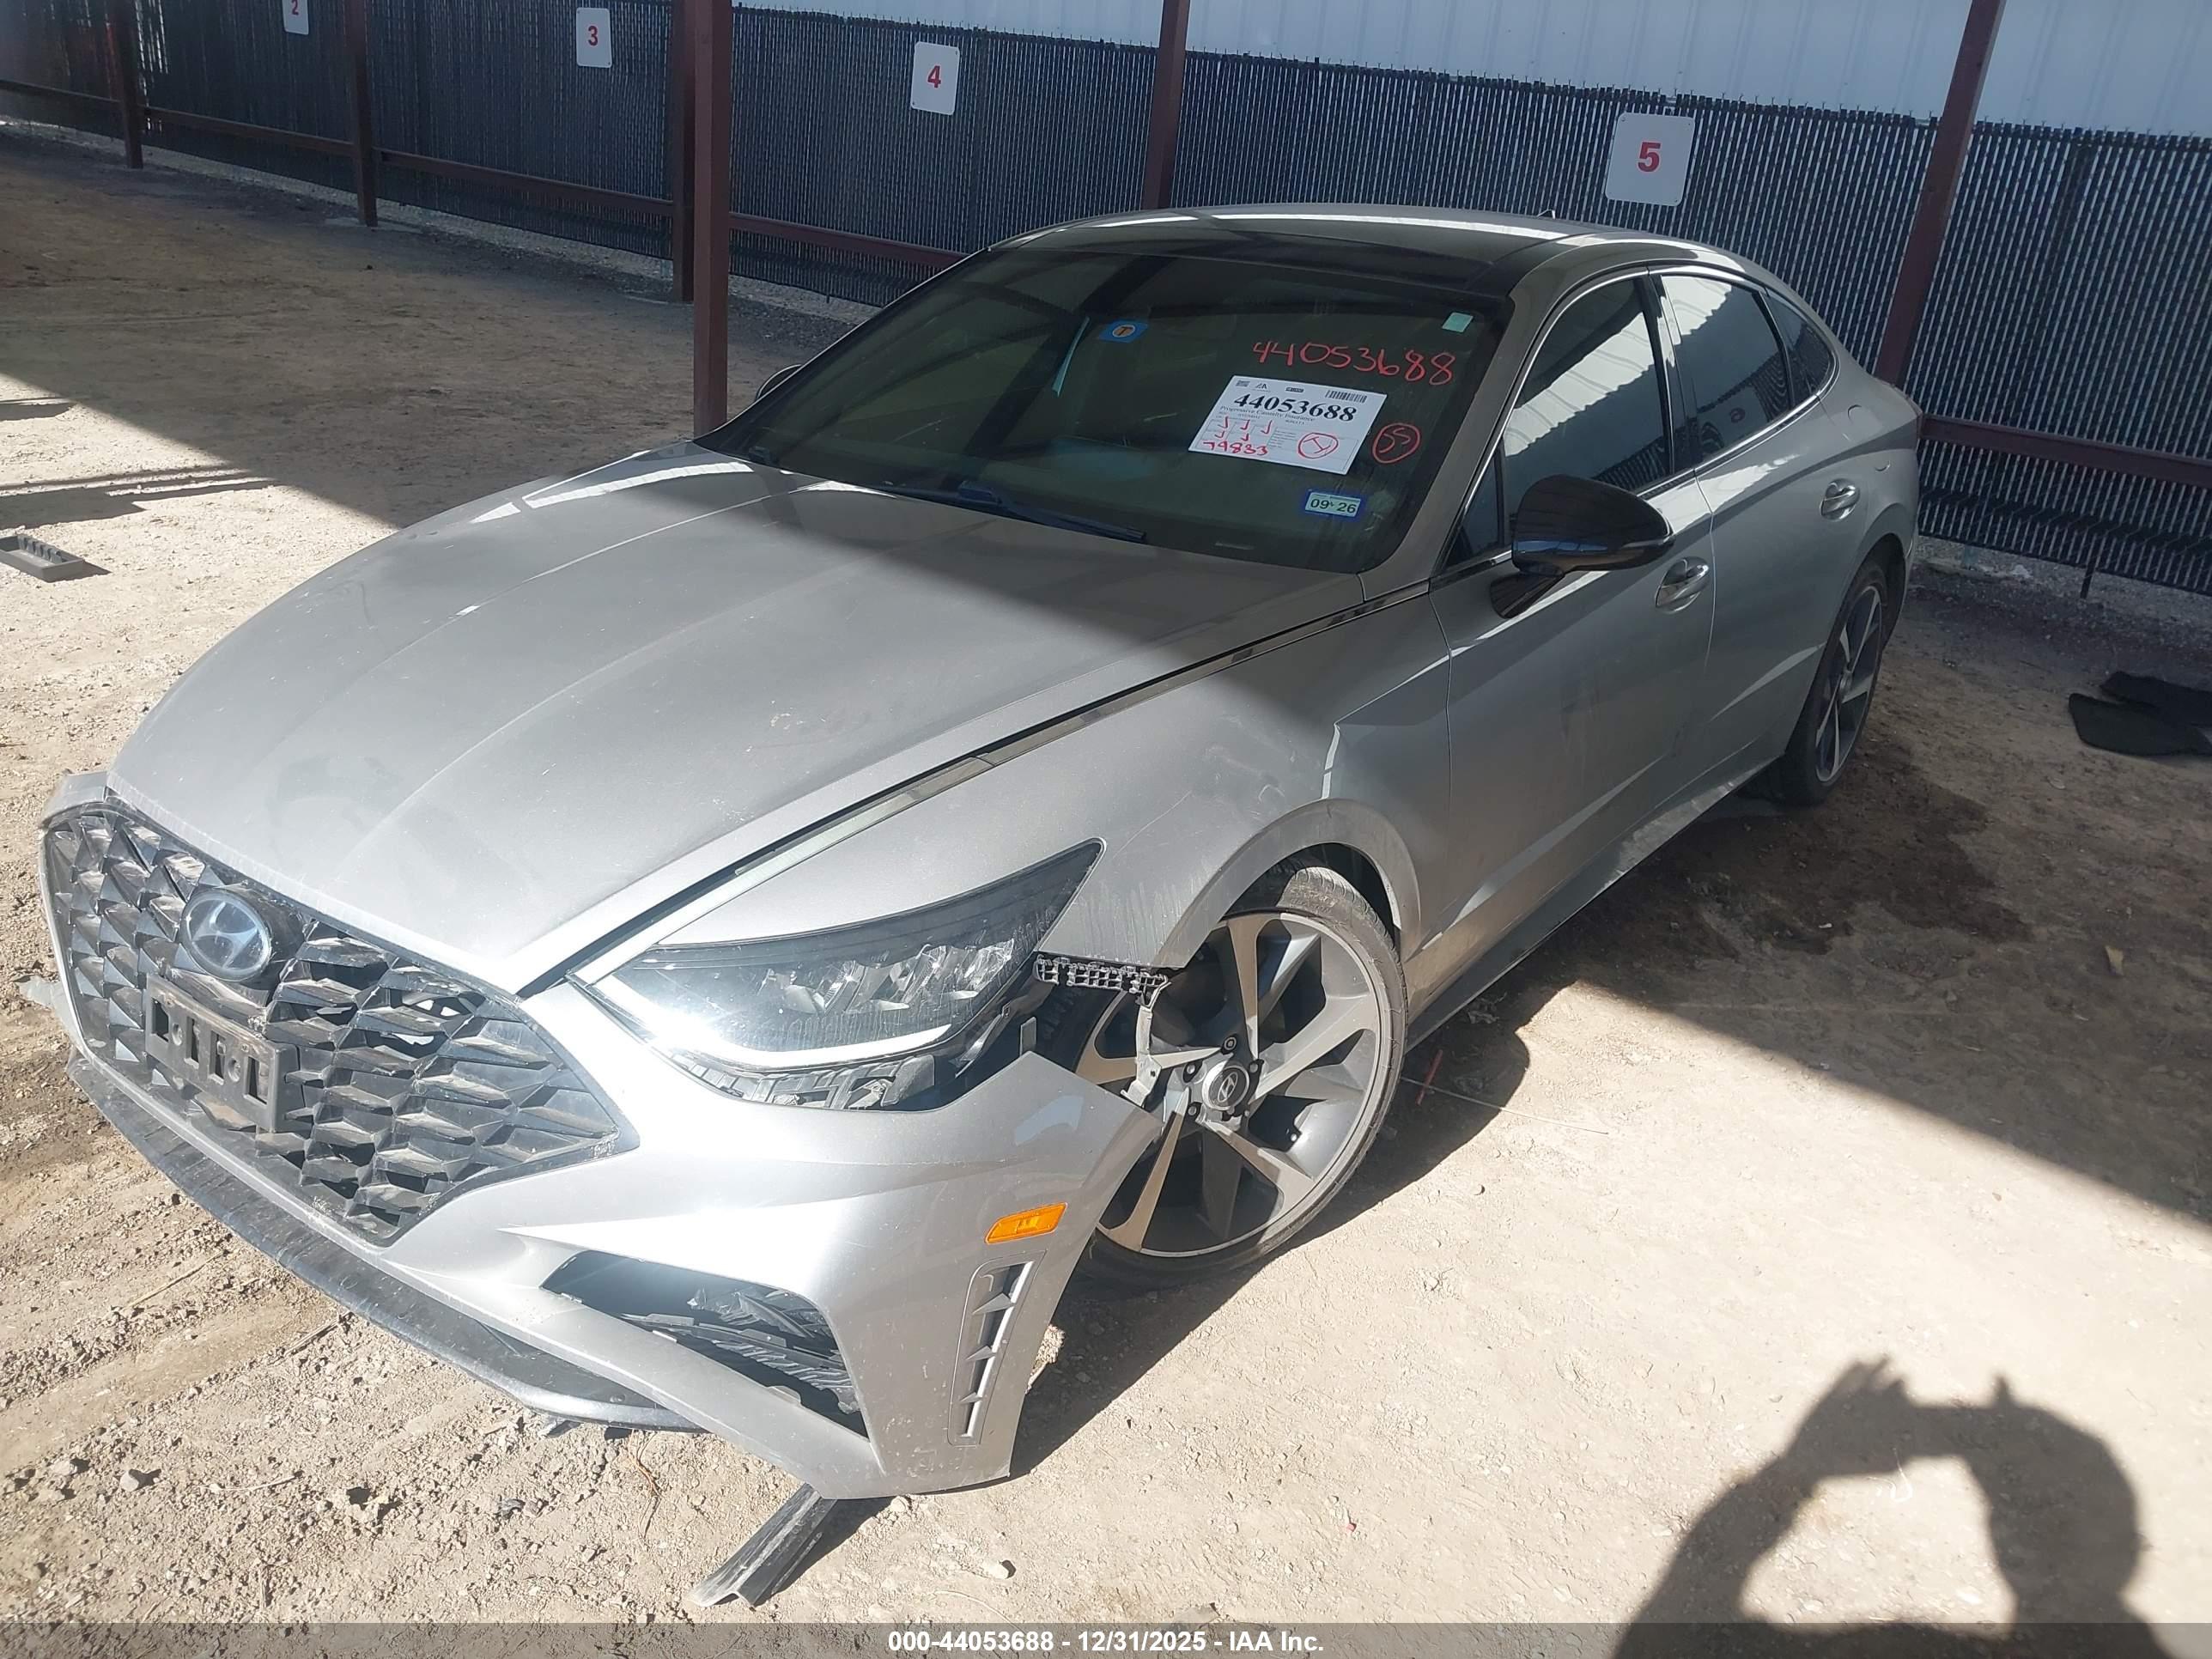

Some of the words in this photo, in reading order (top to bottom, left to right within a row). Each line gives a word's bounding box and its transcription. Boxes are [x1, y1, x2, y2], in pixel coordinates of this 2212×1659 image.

[290, 0, 300, 15] 2
[587, 25, 599, 46] 3
[927, 65, 942, 88] 4
[1638, 142, 1662, 173] 5
[1252, 340, 1456, 386] 44053688
[1234, 393, 1358, 422] 44053688
[1285, 412, 1315, 422] Insurance
[1336, 501, 1357, 514] 26
